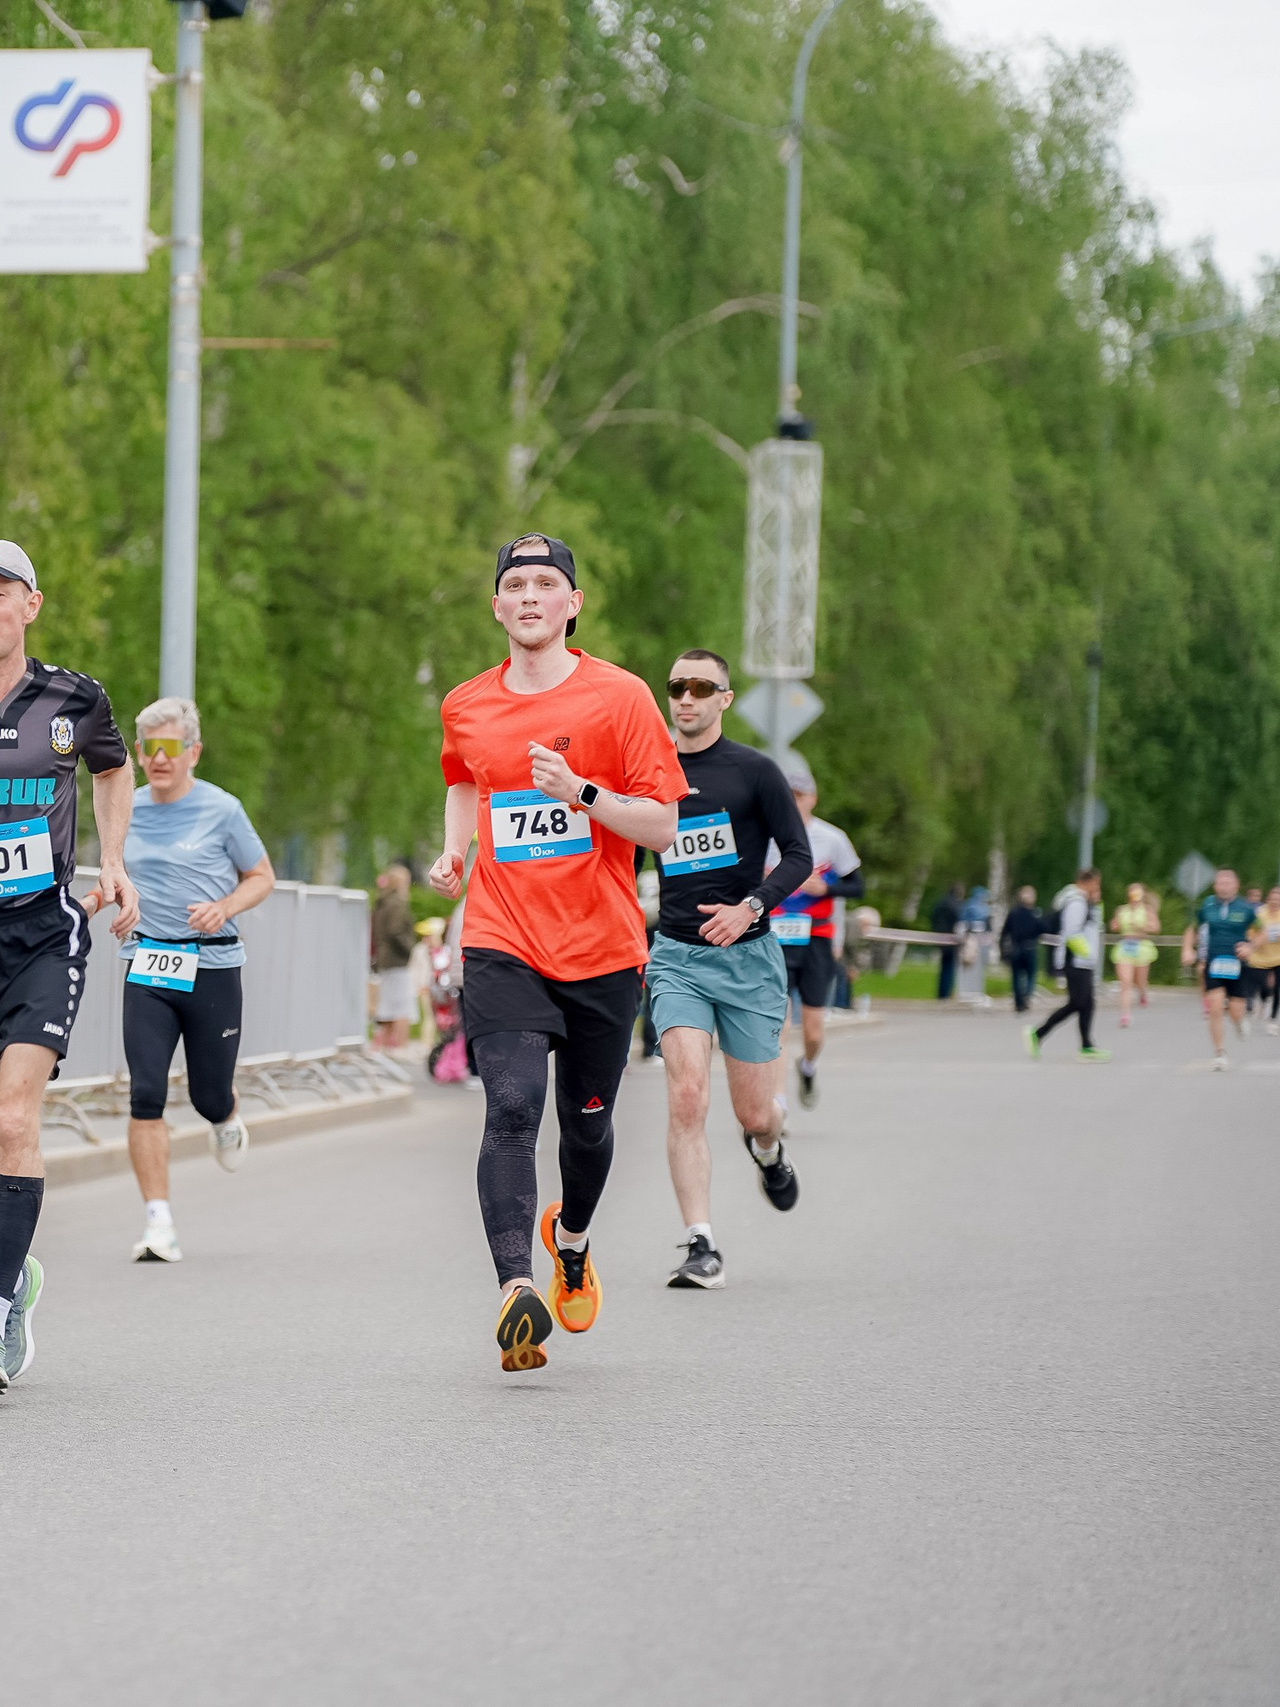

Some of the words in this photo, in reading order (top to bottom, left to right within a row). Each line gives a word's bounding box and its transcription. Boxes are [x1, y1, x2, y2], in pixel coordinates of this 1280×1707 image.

[510, 808, 568, 839] 748
[673, 830, 725, 857] 1086
[147, 953, 183, 973] 709
[42, 1021, 65, 1036] JAKO
